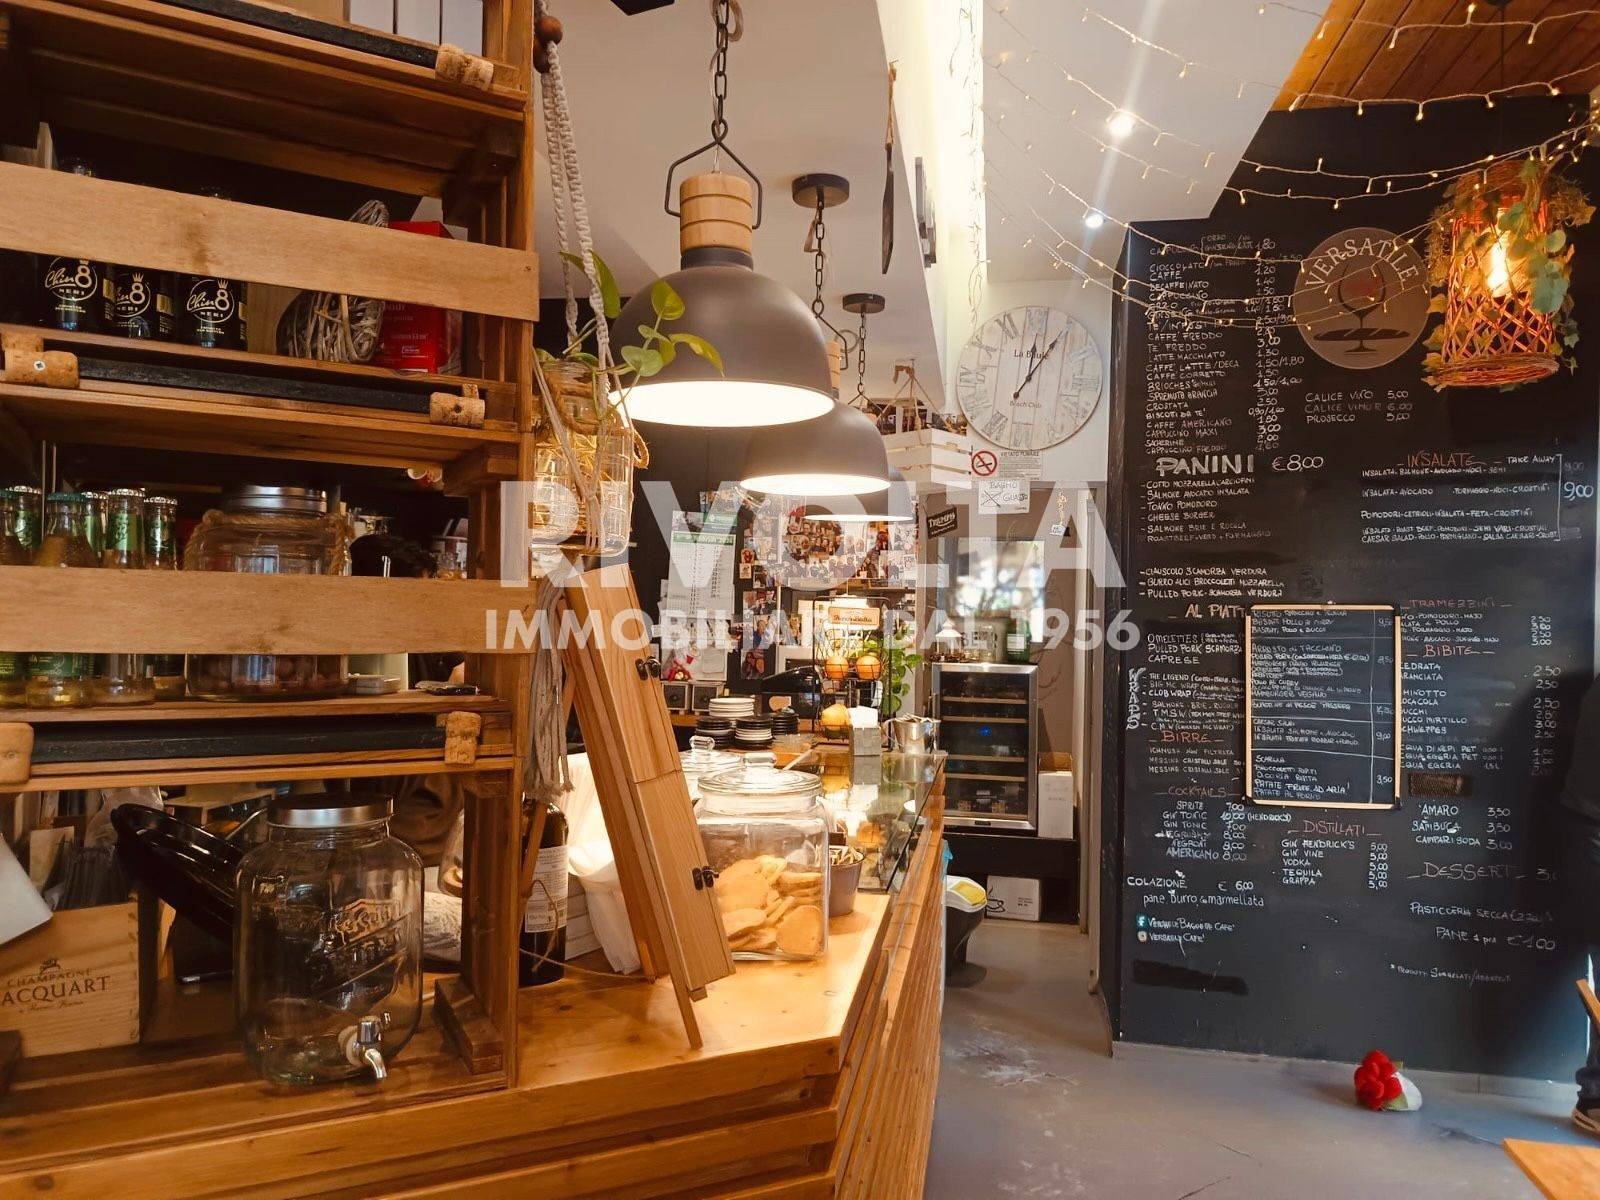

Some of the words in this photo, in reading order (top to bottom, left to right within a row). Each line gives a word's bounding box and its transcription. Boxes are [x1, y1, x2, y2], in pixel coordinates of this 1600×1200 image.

[1305, 237, 1419, 286] VERSATILE
[1305, 392, 1343, 402] CALICE
[1156, 454, 1254, 476] PANINI
[1185, 603, 1202, 618] AL
[1208, 603, 1245, 619] PIATT
[1425, 644, 1472, 657] BIBITE
[1148, 655, 1200, 664] CAPRESE
[1161, 730, 1212, 743] BIRRE
[1282, 869, 1323, 878] TEQUILA
[1127, 876, 1188, 889] COLAZIONE
[1282, 877, 1315, 885] GRAPPA
[1, 976, 110, 1006] ACQUART
